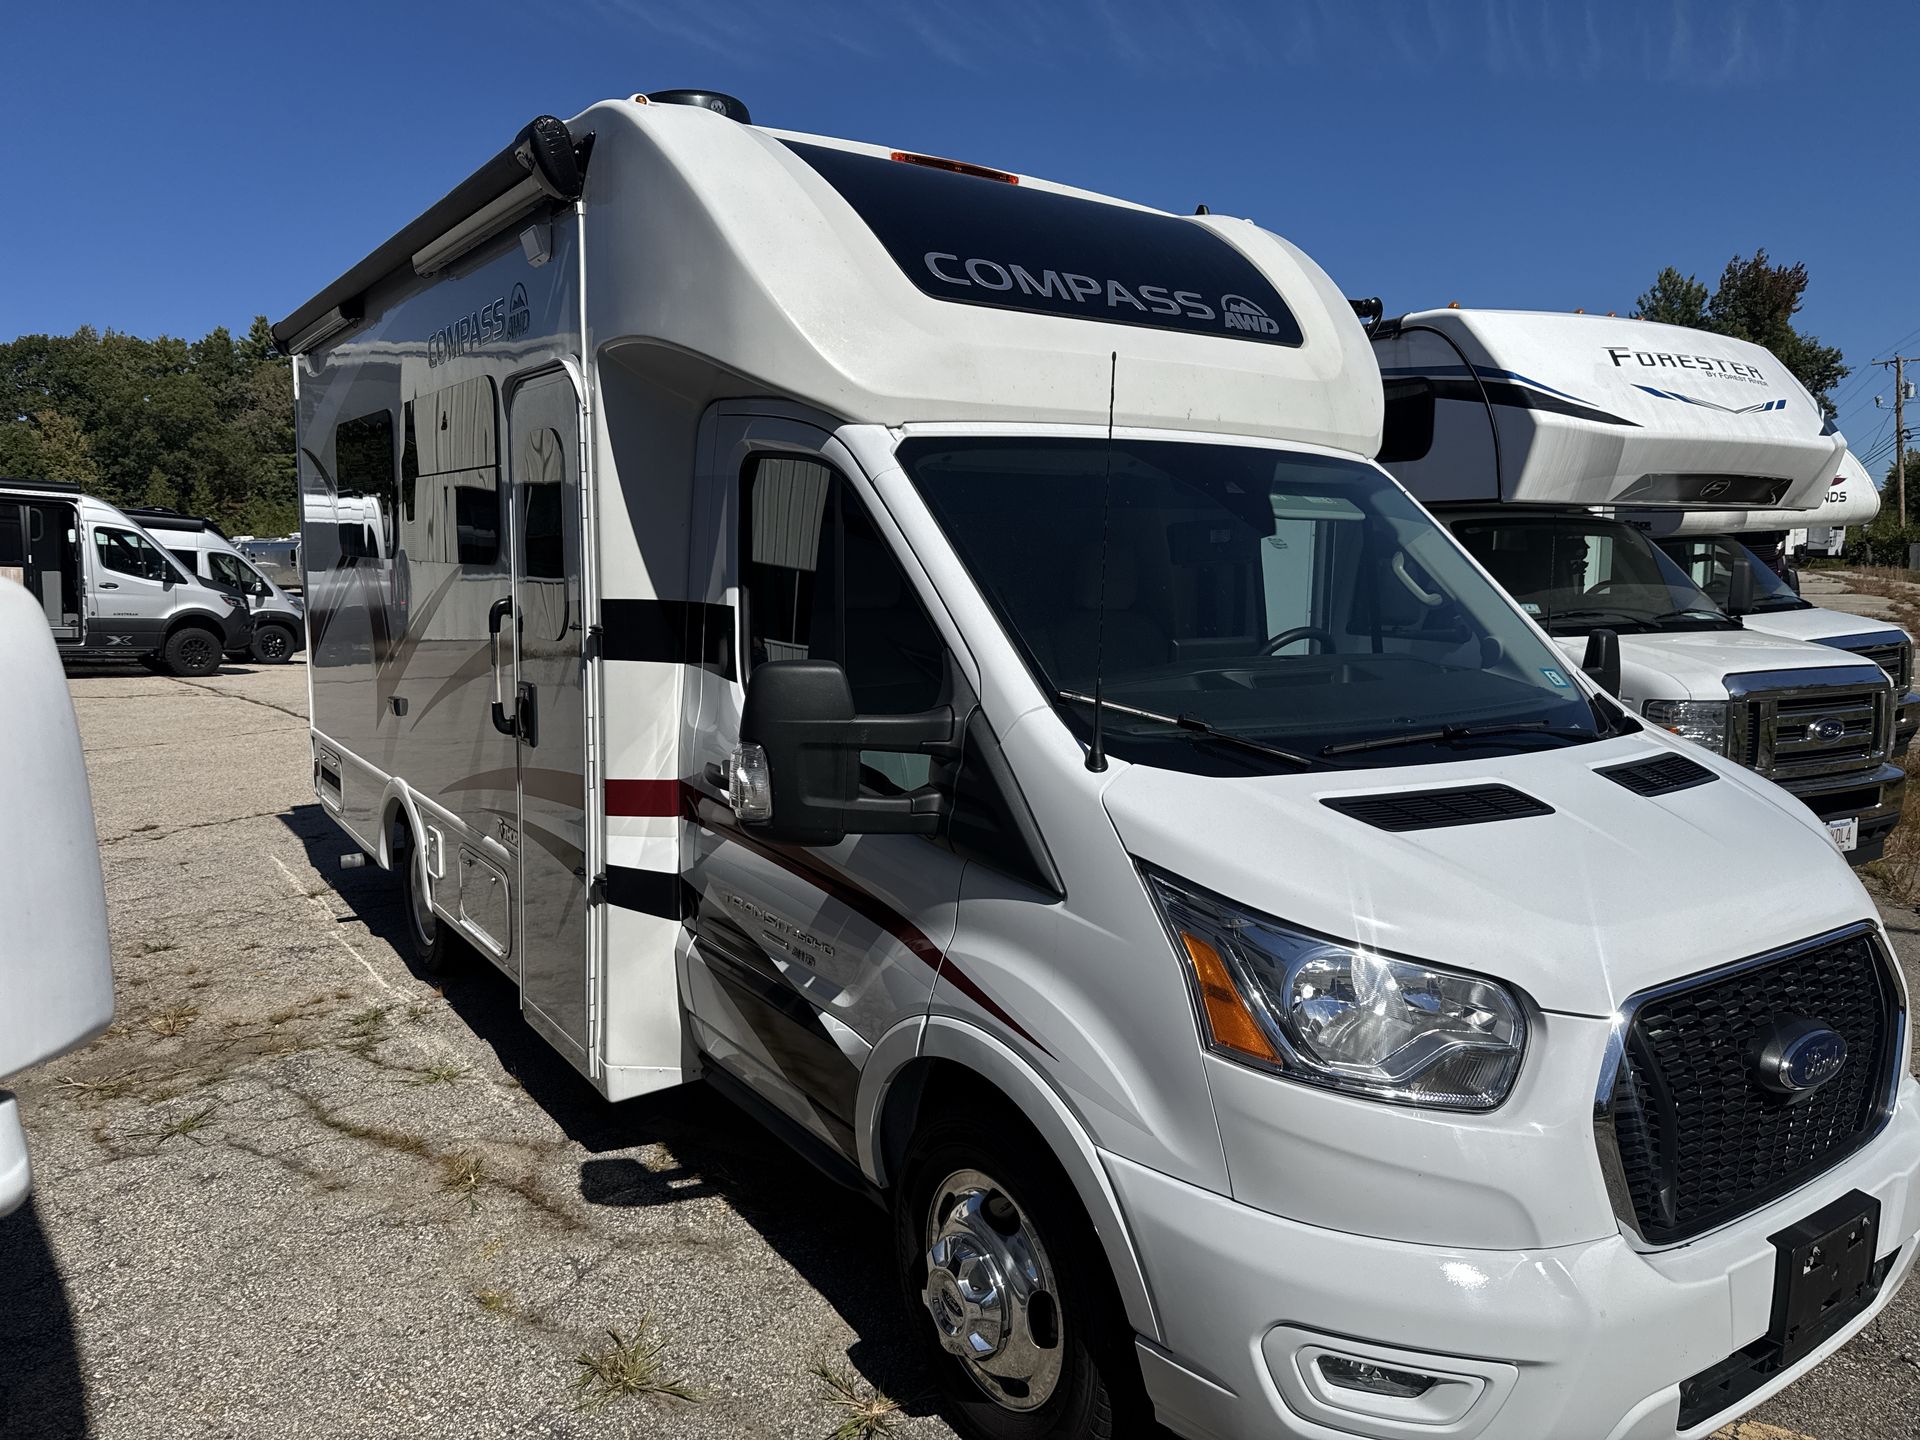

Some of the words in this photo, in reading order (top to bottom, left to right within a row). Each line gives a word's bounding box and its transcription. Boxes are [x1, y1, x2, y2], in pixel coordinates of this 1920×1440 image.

[924, 251, 1216, 320] COMPASS
[1224, 313, 1280, 335] AWD
[427, 297, 505, 369] COMPASS
[507, 309, 530, 341] AWD
[1601, 346, 1764, 380] FORESTER
[1719, 372, 1748, 383] FOREST
[721, 890, 793, 934] TRANSIT
